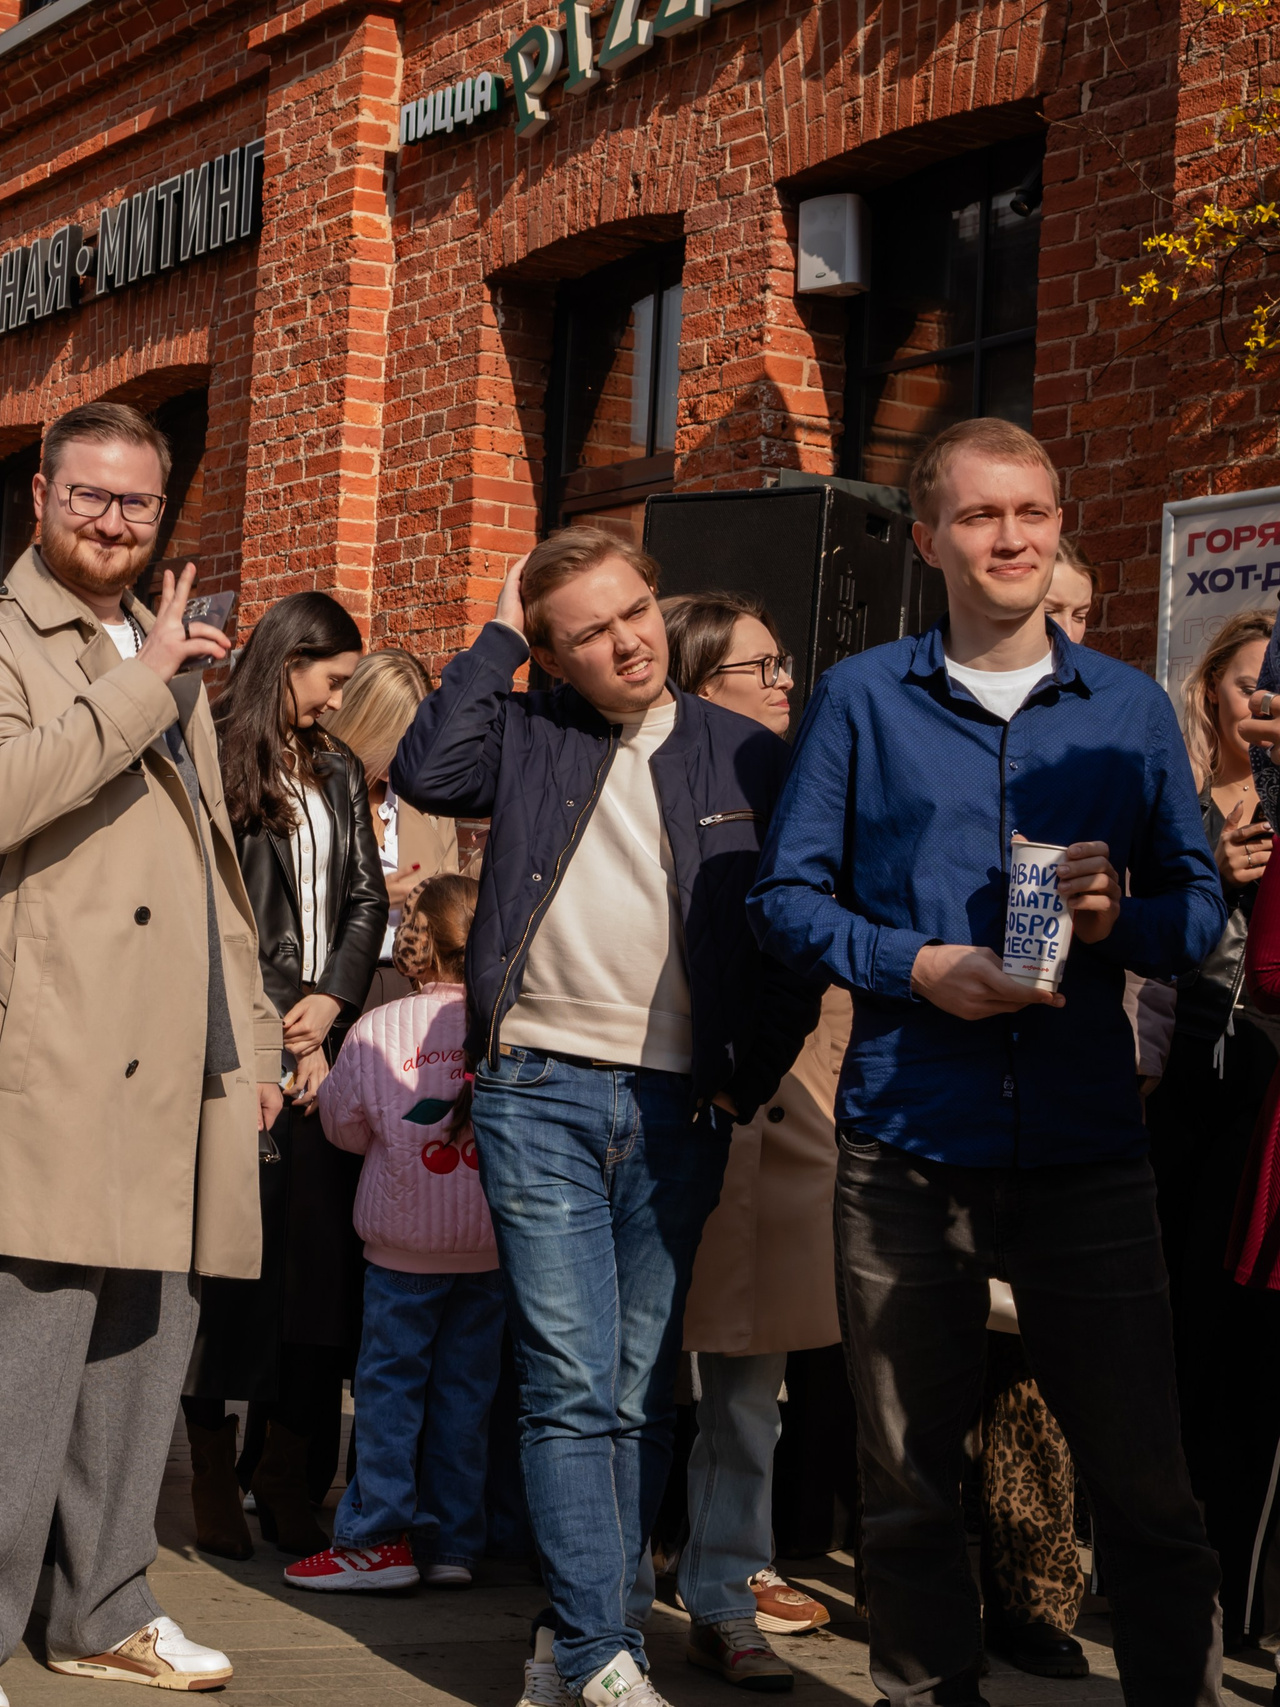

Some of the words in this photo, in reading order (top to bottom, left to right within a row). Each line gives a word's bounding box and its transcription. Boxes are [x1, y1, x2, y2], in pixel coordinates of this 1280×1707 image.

[400, 71, 494, 144] ПИЦЦА
[96, 137, 264, 294] МИТИНГ
[1010, 863, 1061, 890] АВАЙ
[403, 1046, 464, 1072] above
